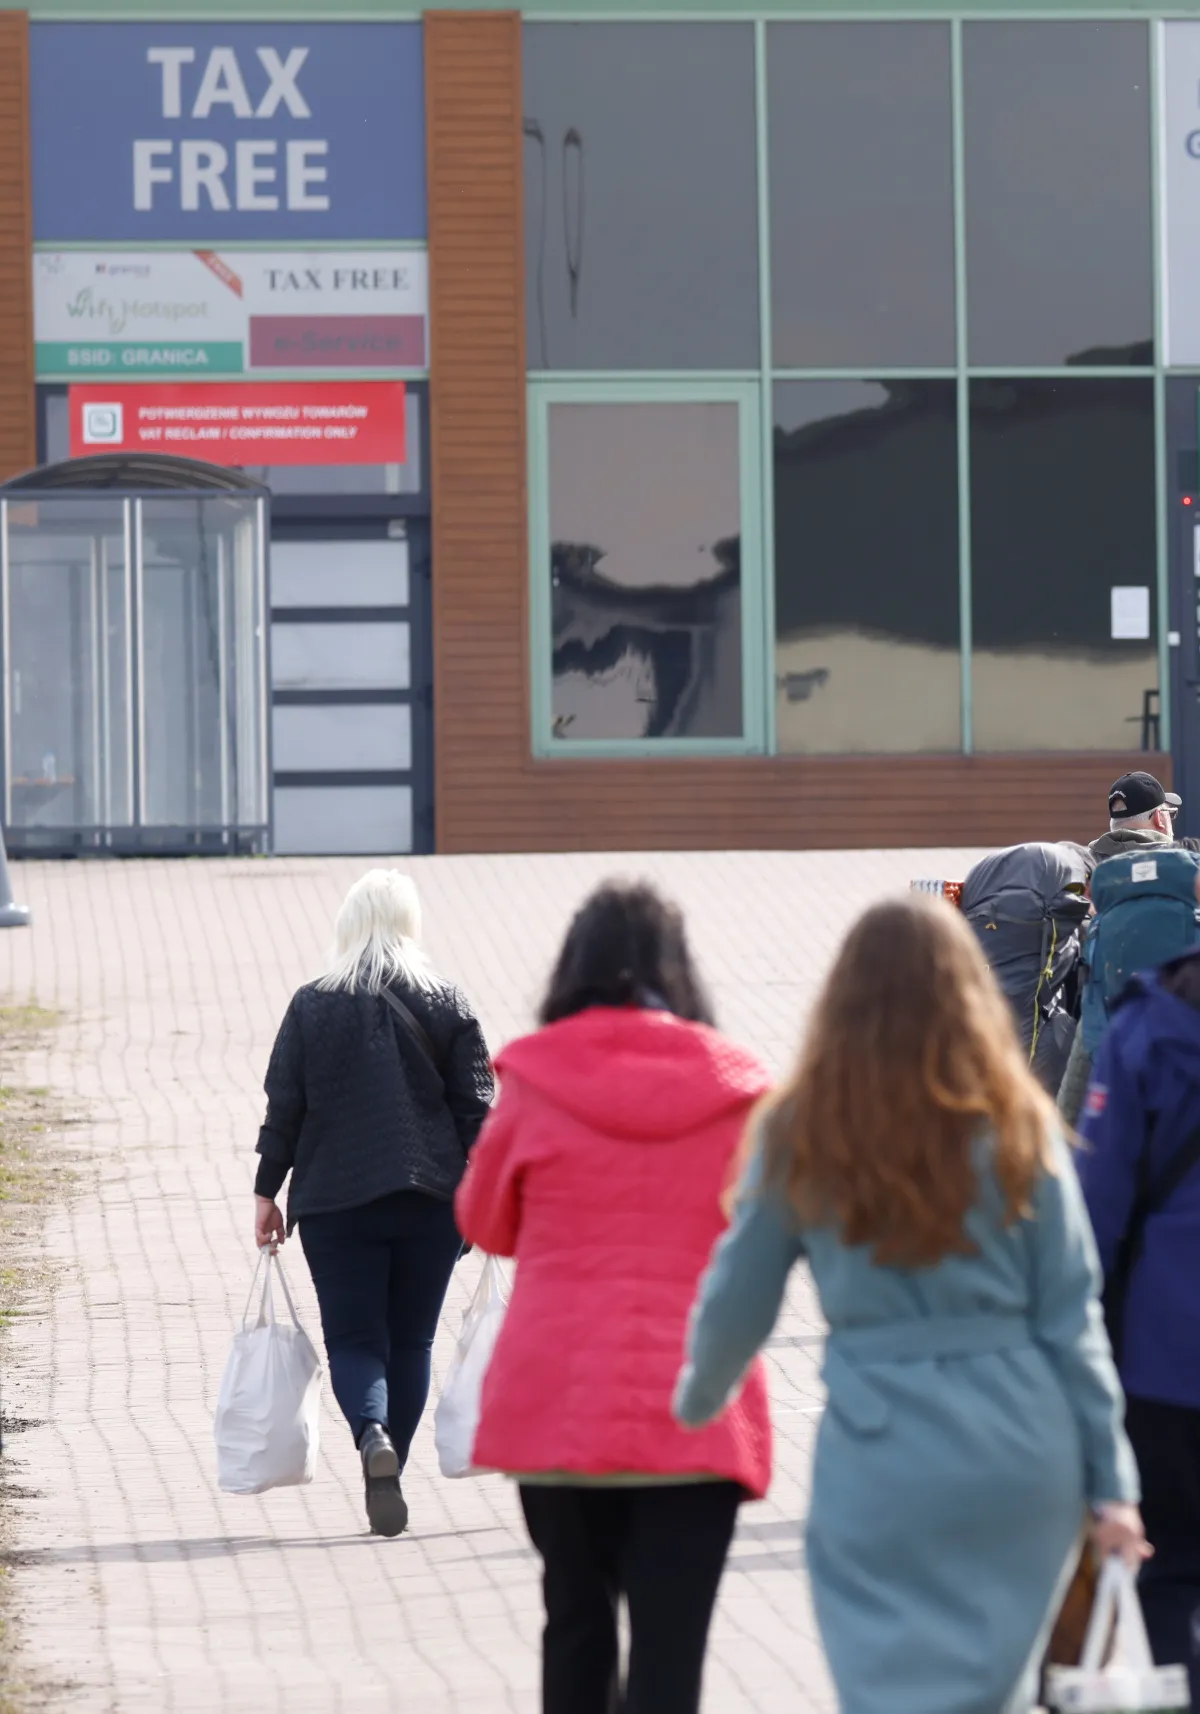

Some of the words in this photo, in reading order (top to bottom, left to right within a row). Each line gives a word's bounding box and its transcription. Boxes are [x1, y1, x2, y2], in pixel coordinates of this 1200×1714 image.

[148, 47, 311, 118] TAX
[133, 140, 329, 211] FREE
[264, 268, 322, 290] TAX
[333, 268, 410, 290] FREE
[121, 348, 209, 366] GRANICA
[324, 426, 357, 439] ONLY
